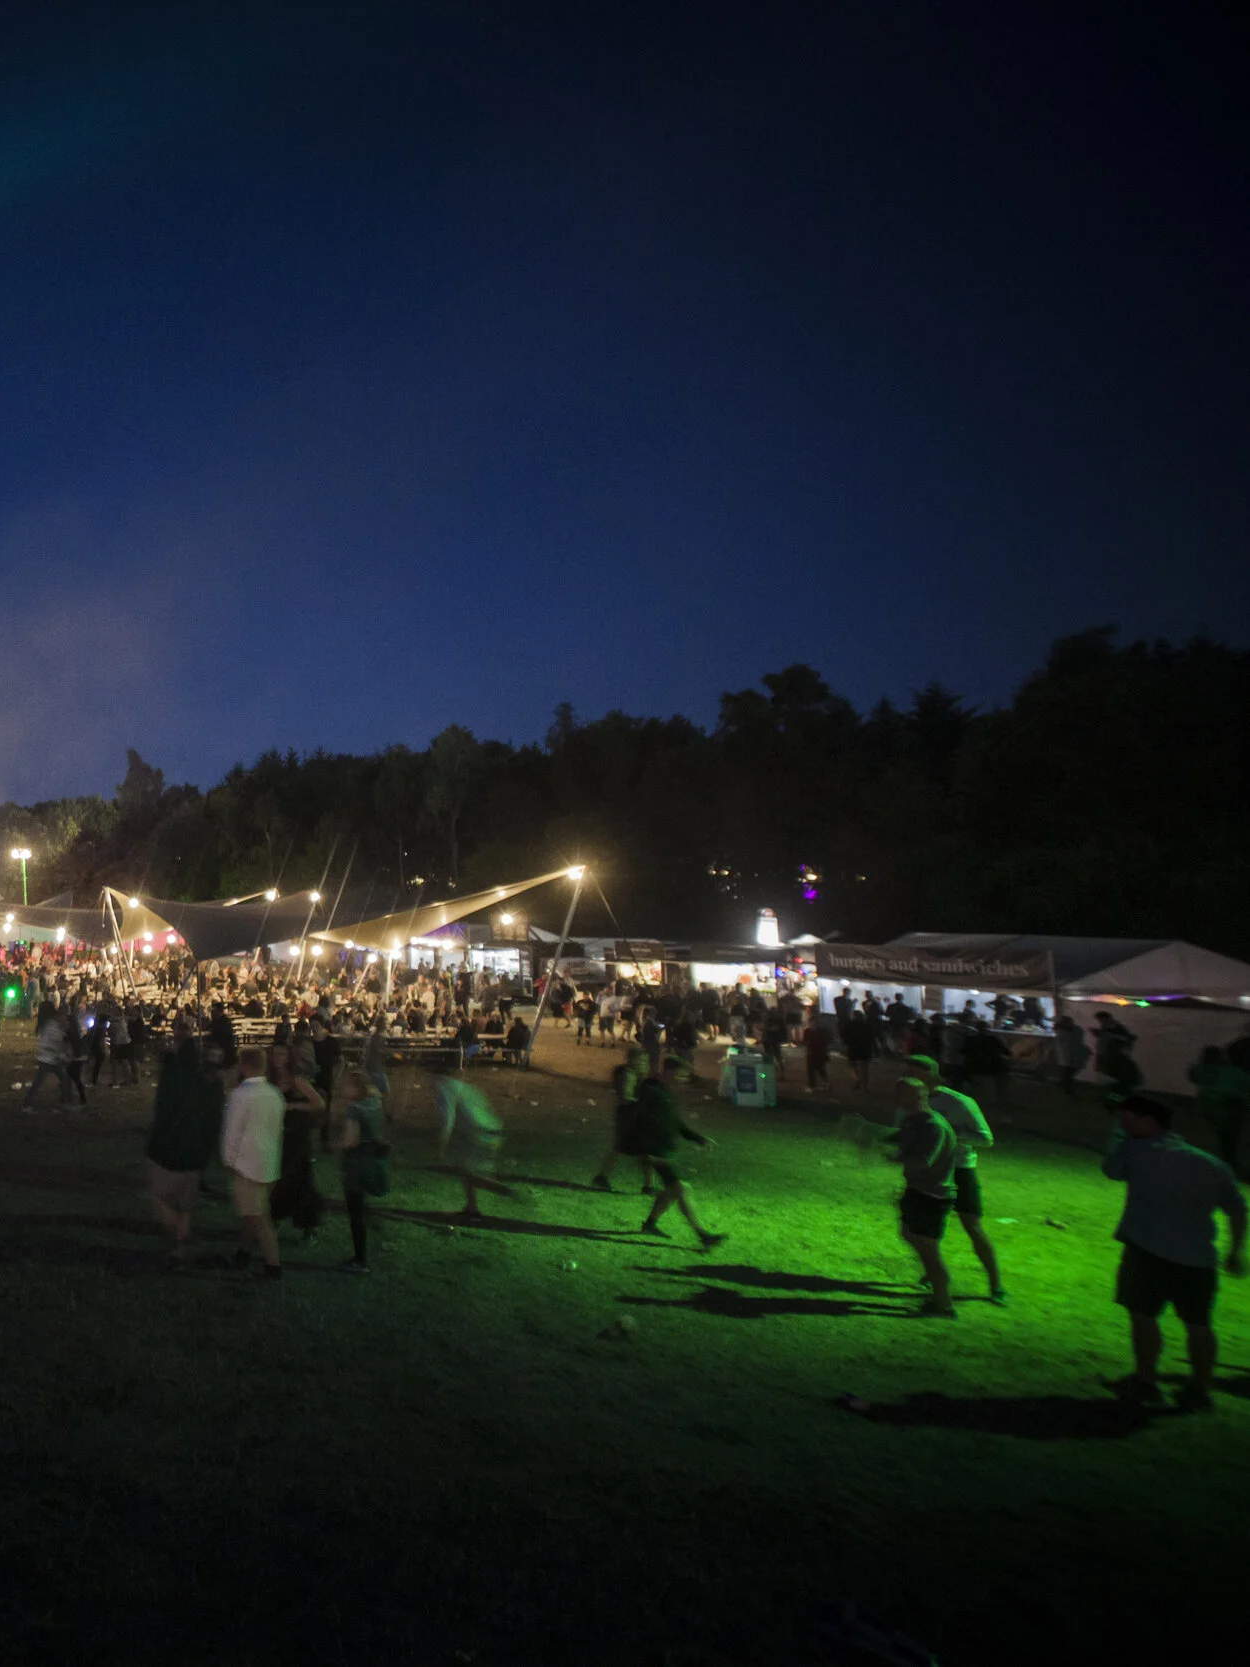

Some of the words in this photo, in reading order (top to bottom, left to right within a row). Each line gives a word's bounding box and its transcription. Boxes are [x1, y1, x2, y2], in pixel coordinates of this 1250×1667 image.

[829, 952, 886, 971] burgers
[889, 956, 919, 973] and
[922, 958, 1029, 978] sandwiches
